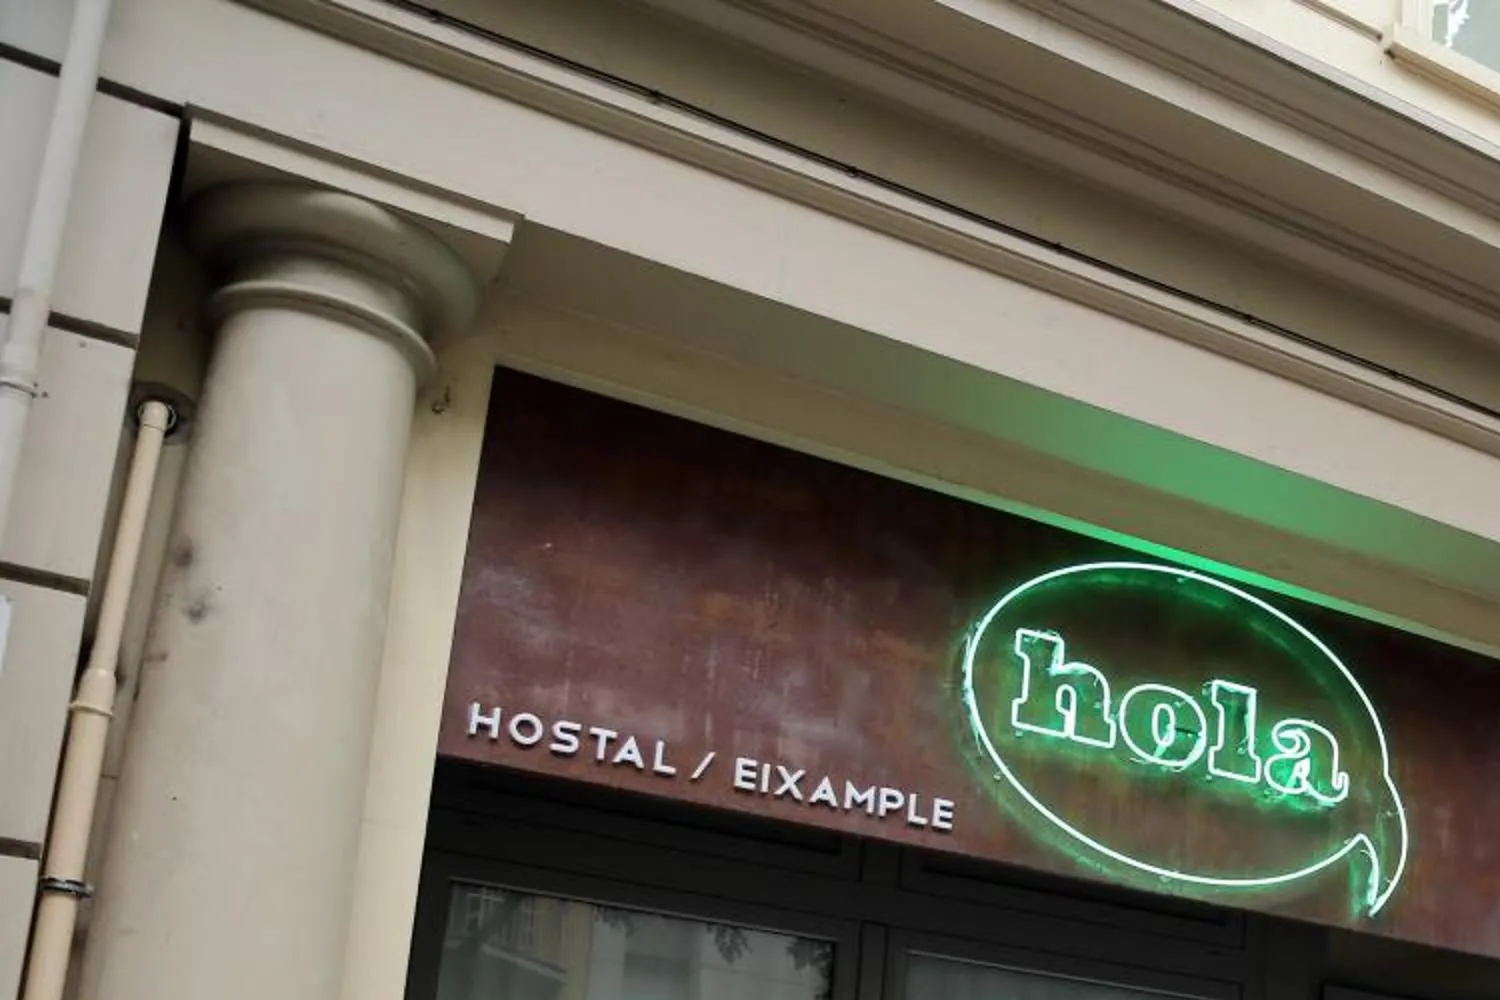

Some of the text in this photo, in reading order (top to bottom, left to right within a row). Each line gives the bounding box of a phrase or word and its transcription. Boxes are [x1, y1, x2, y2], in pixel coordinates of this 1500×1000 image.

[468, 702, 956, 830] HOSTAL / EIXAMPLE
[1010, 628, 1349, 802] hola
